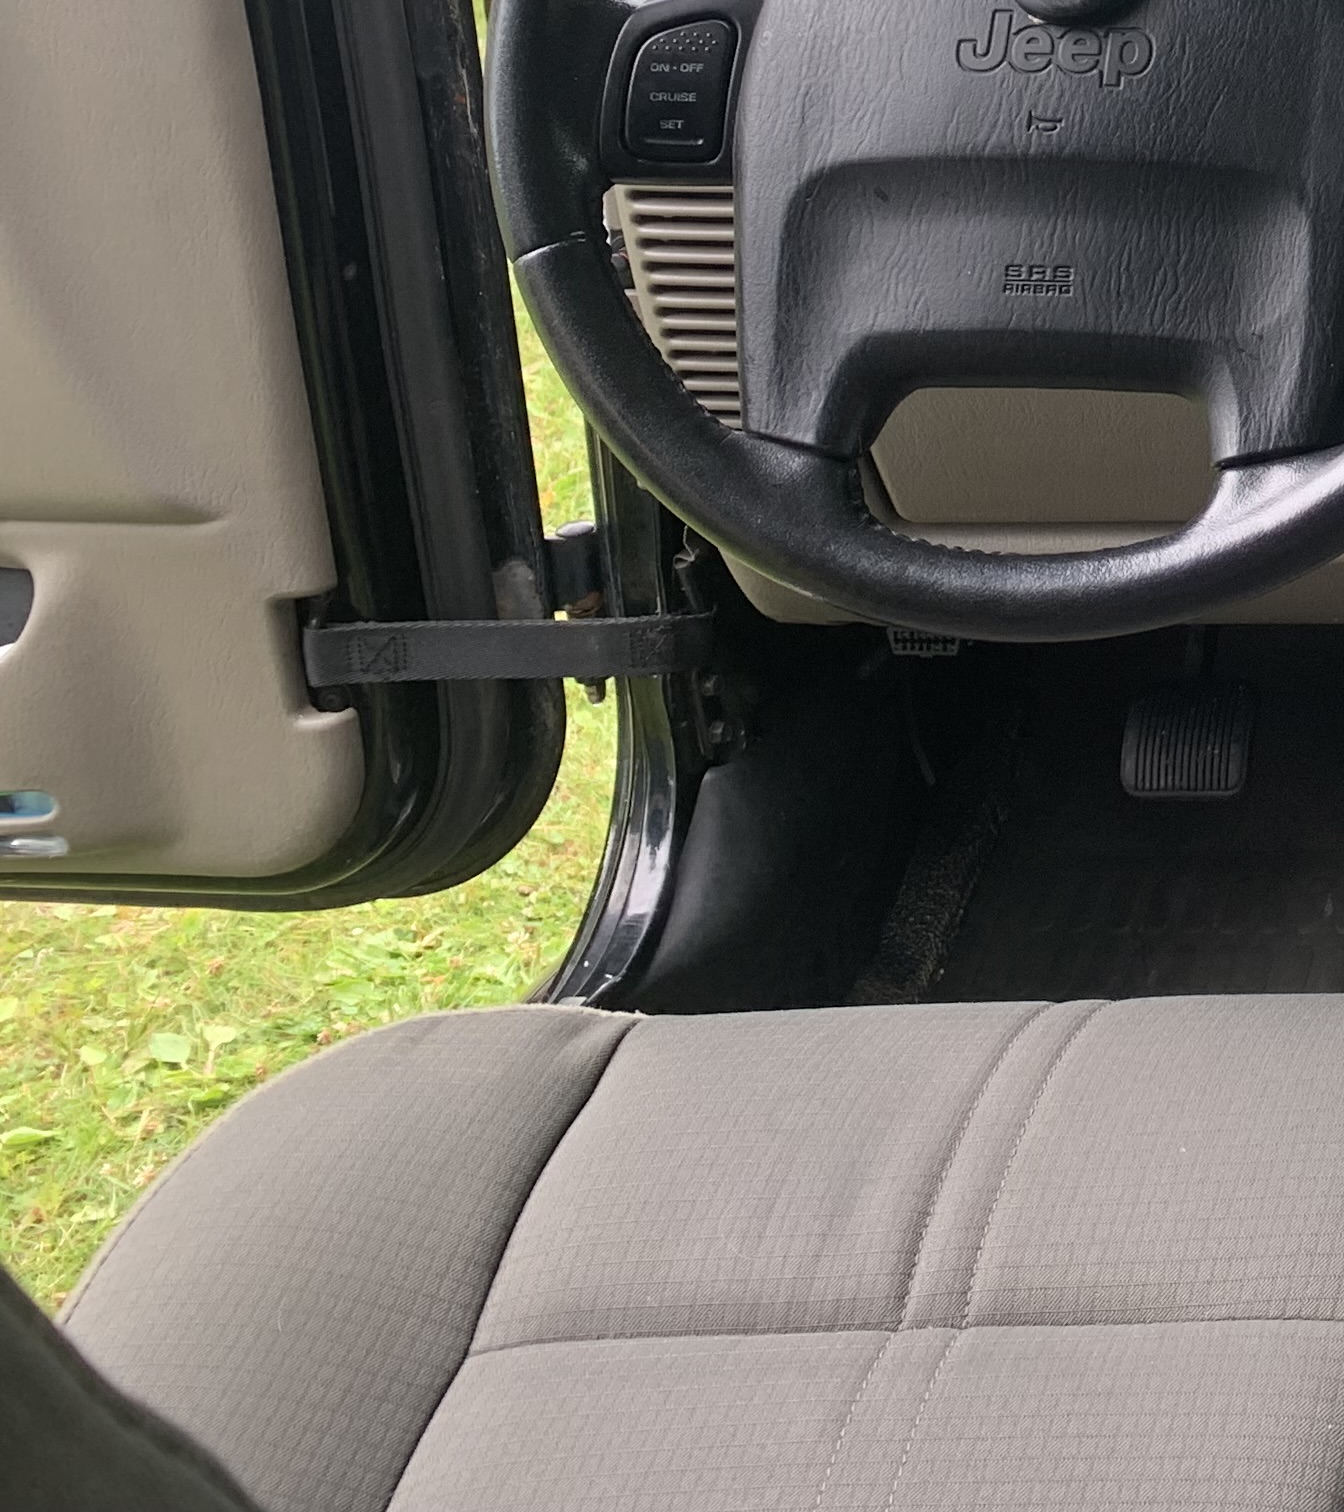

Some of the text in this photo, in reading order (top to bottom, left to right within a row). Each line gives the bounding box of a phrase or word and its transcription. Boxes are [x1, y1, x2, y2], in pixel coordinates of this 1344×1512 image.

[956, 8, 1156, 89] Jeep
[649, 91, 697, 102] CRUISE
[659, 119, 685, 129] SET
[1004, 264, 1074, 280] SRS
[1002, 283, 1074, 297] AIRBAG
